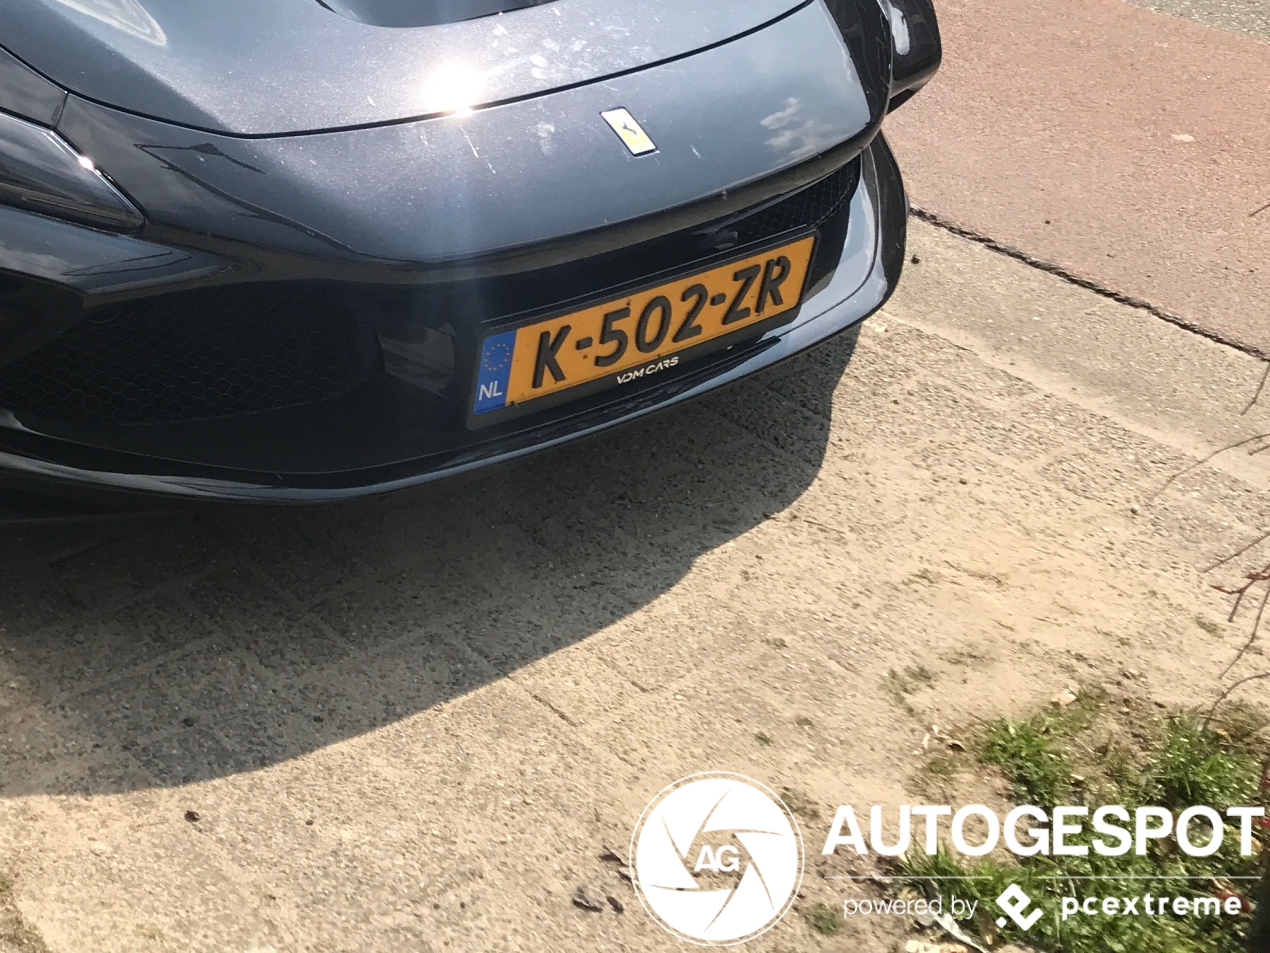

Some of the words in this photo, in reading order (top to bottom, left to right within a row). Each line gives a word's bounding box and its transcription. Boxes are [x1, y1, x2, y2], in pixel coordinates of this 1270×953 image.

[532, 255, 791, 389] K-502-ZR
[616, 366, 645, 385] VDM
[645, 356, 680, 375] CARS
[479, 380, 503, 401] NL
